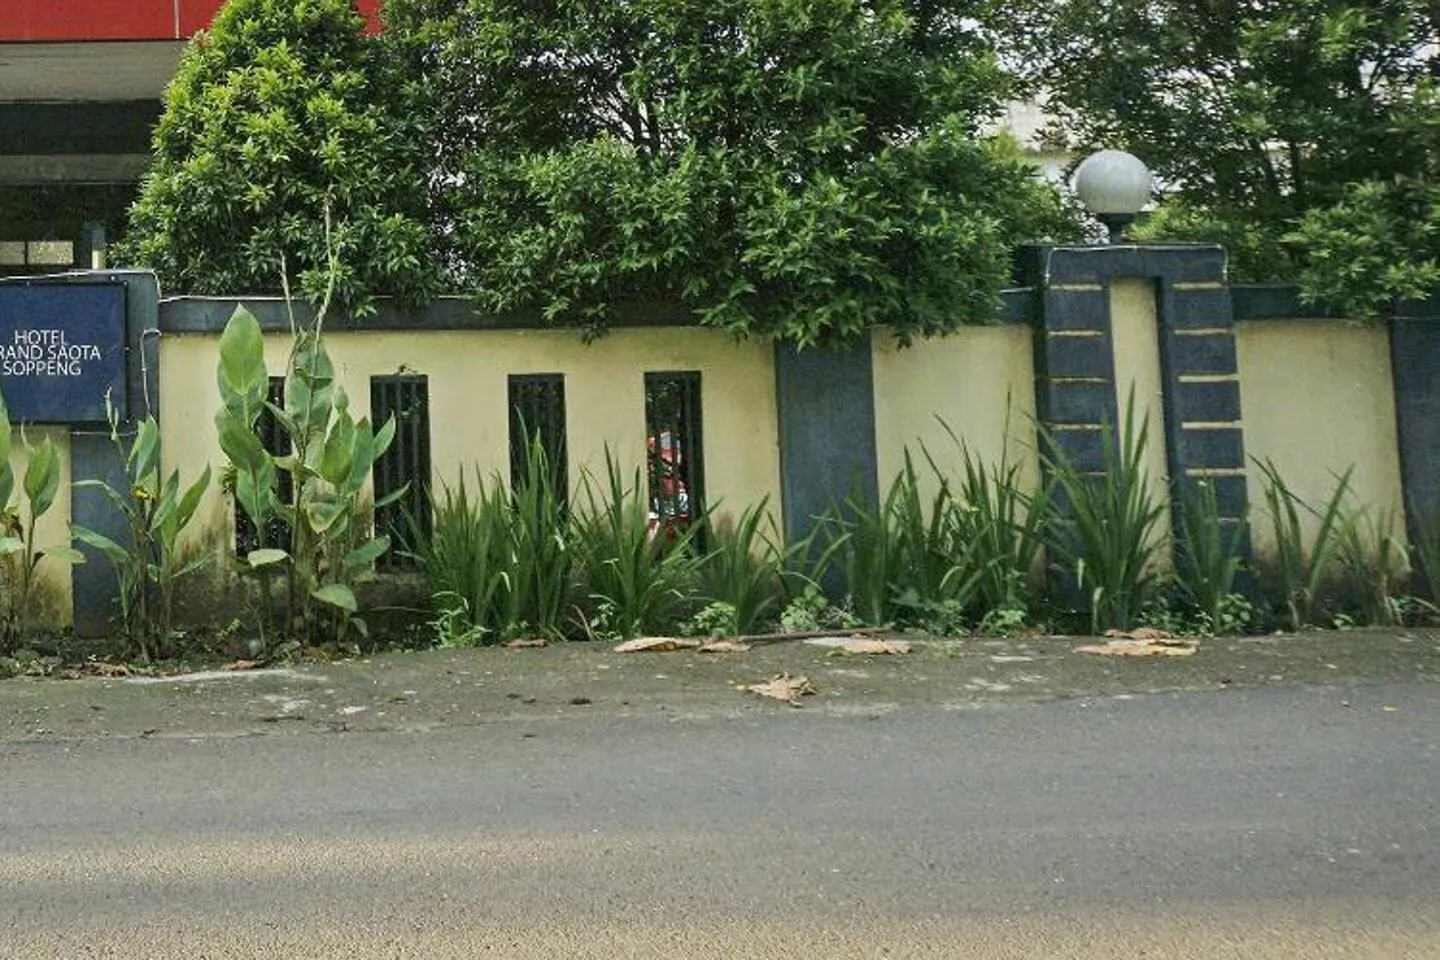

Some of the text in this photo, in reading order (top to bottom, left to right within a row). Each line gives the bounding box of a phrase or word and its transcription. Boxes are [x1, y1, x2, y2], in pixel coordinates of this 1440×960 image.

[14, 329, 68, 345] HOTEL
[47, 345, 102, 361] SAOTA
[2, 360, 82, 376] SOPPENG
